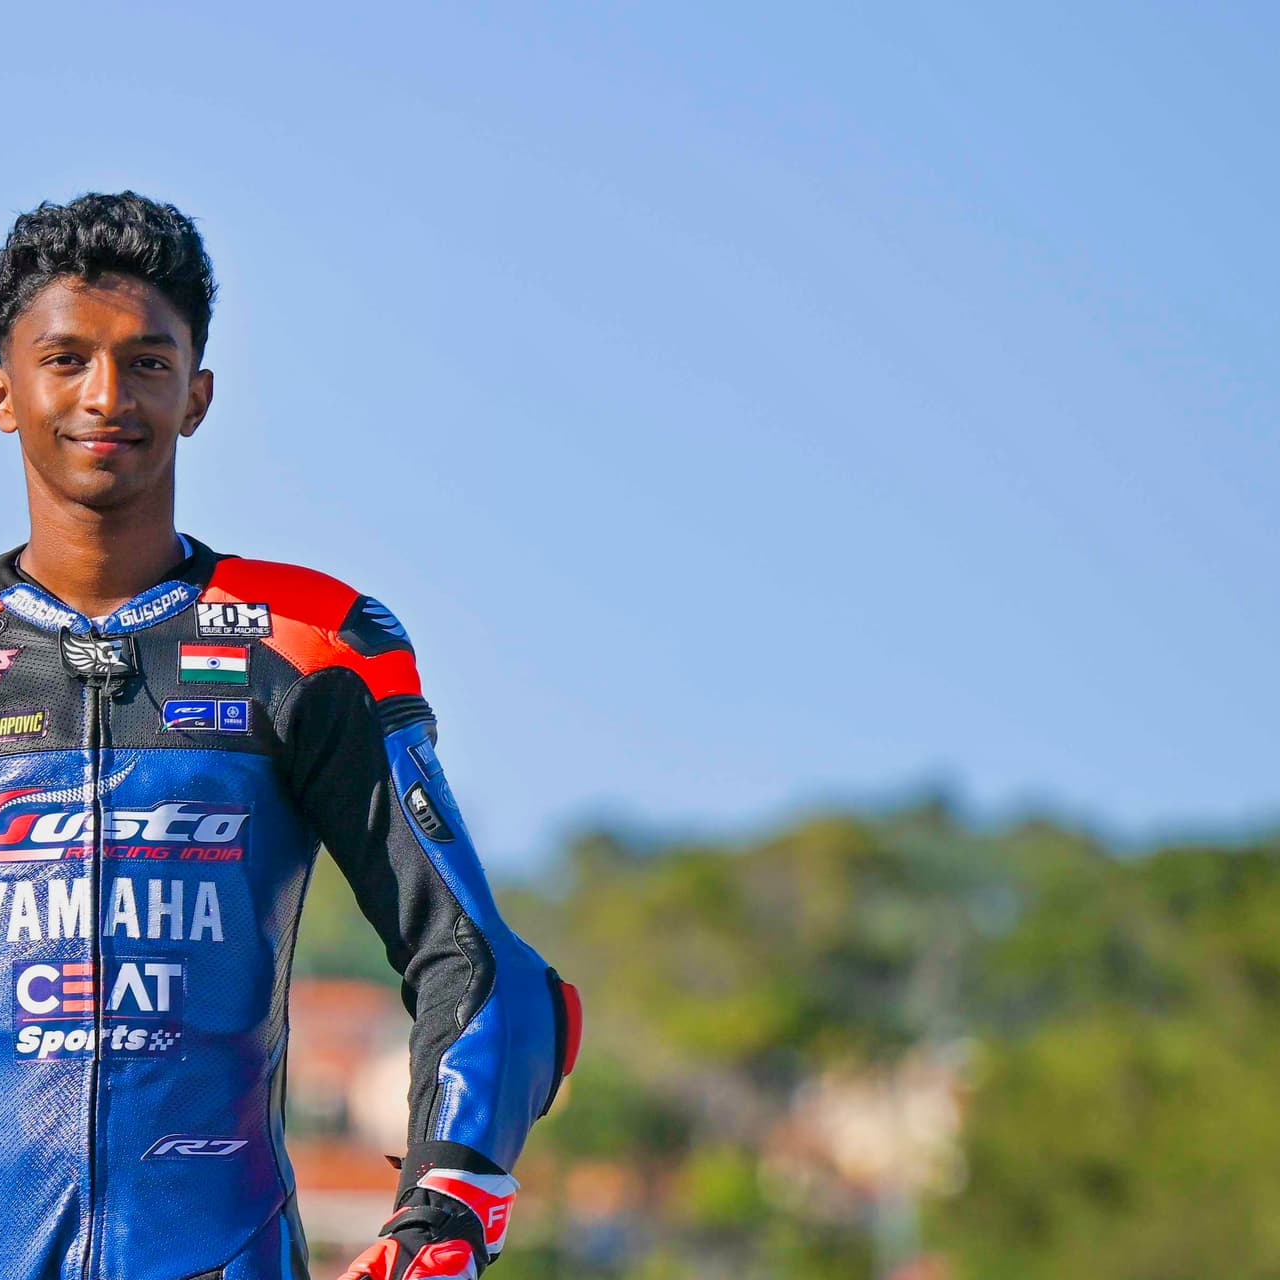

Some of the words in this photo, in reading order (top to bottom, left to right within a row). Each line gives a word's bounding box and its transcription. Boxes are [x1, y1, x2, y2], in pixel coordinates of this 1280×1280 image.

[180, 846, 244, 861] INDIA
[16, 962, 182, 1015] CEAT
[16, 1024, 149, 1059] Sports
[152, 1140, 249, 1156] R7
